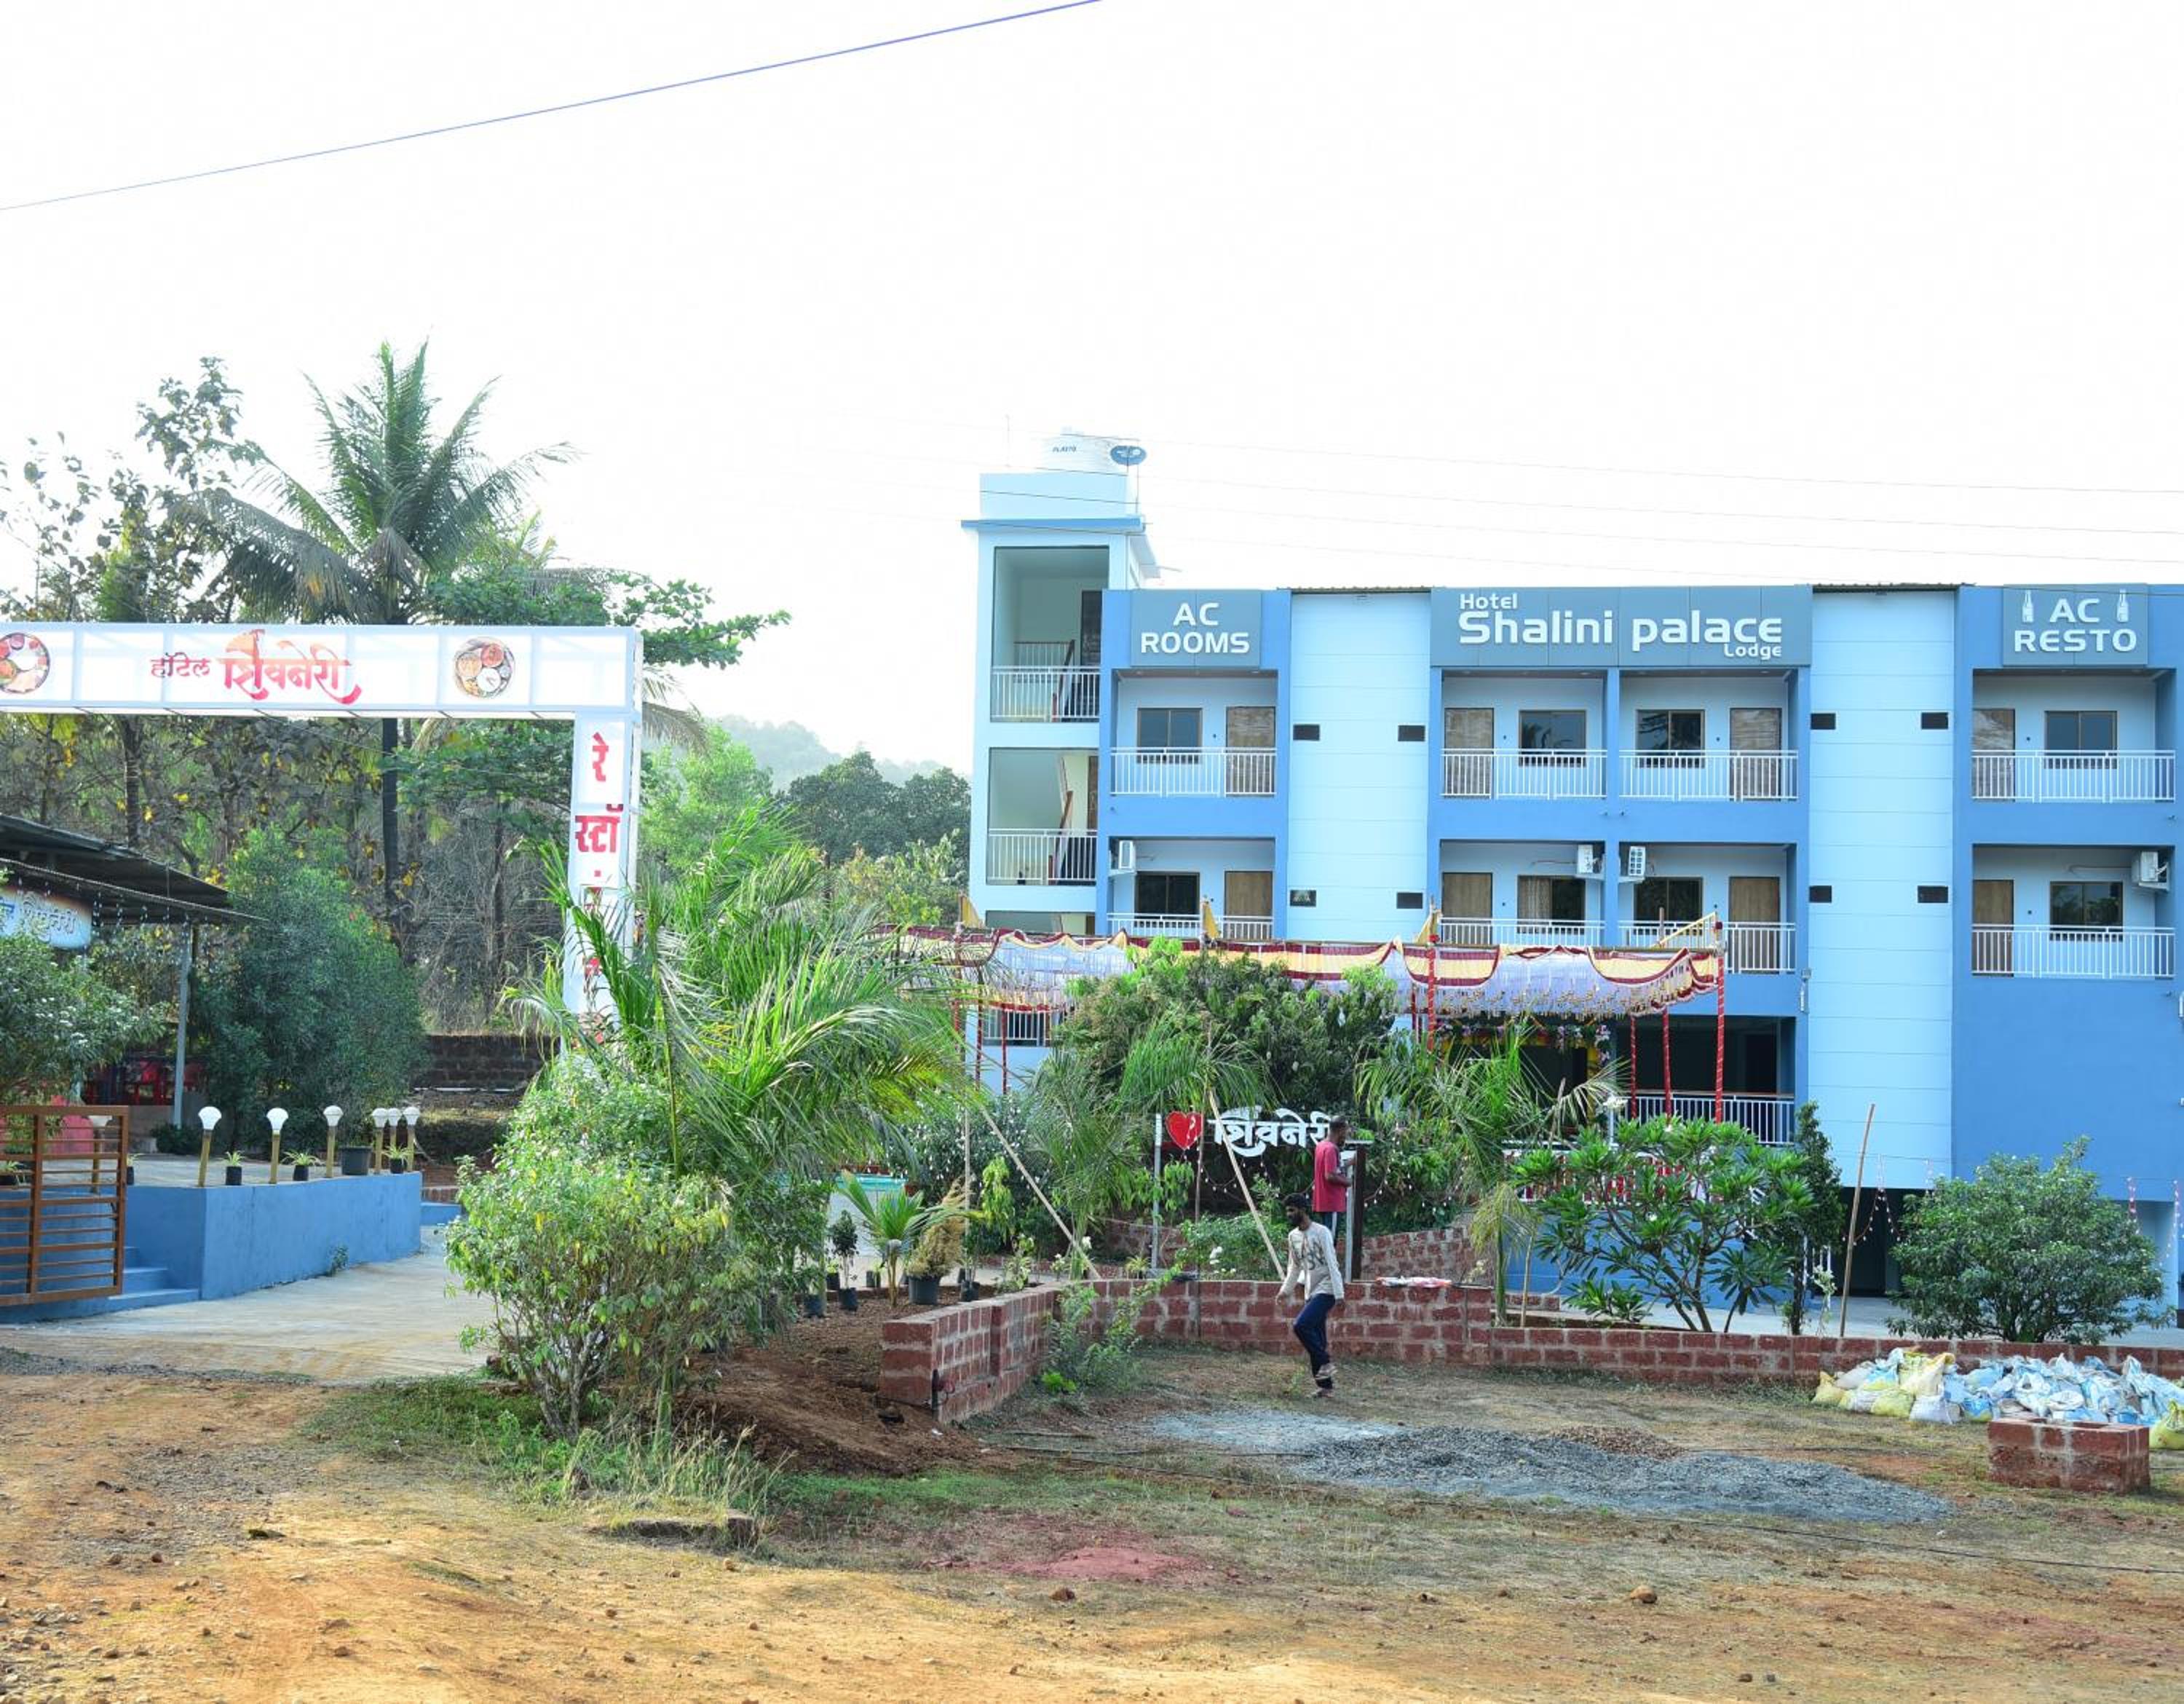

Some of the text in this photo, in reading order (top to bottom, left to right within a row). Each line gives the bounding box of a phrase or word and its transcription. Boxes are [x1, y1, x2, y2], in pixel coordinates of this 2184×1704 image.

[1459, 593, 1518, 610] Hotel
[2049, 598, 2100, 623] AC
[1173, 602, 1219, 626] AC
[1141, 631, 1250, 653] ROOMS
[1458, 610, 1783, 652] Shalini palace
[2014, 628, 2137, 652] RESTO
[1723, 643, 1782, 660] Lodge
[218, 628, 363, 705] शिवनेरी
